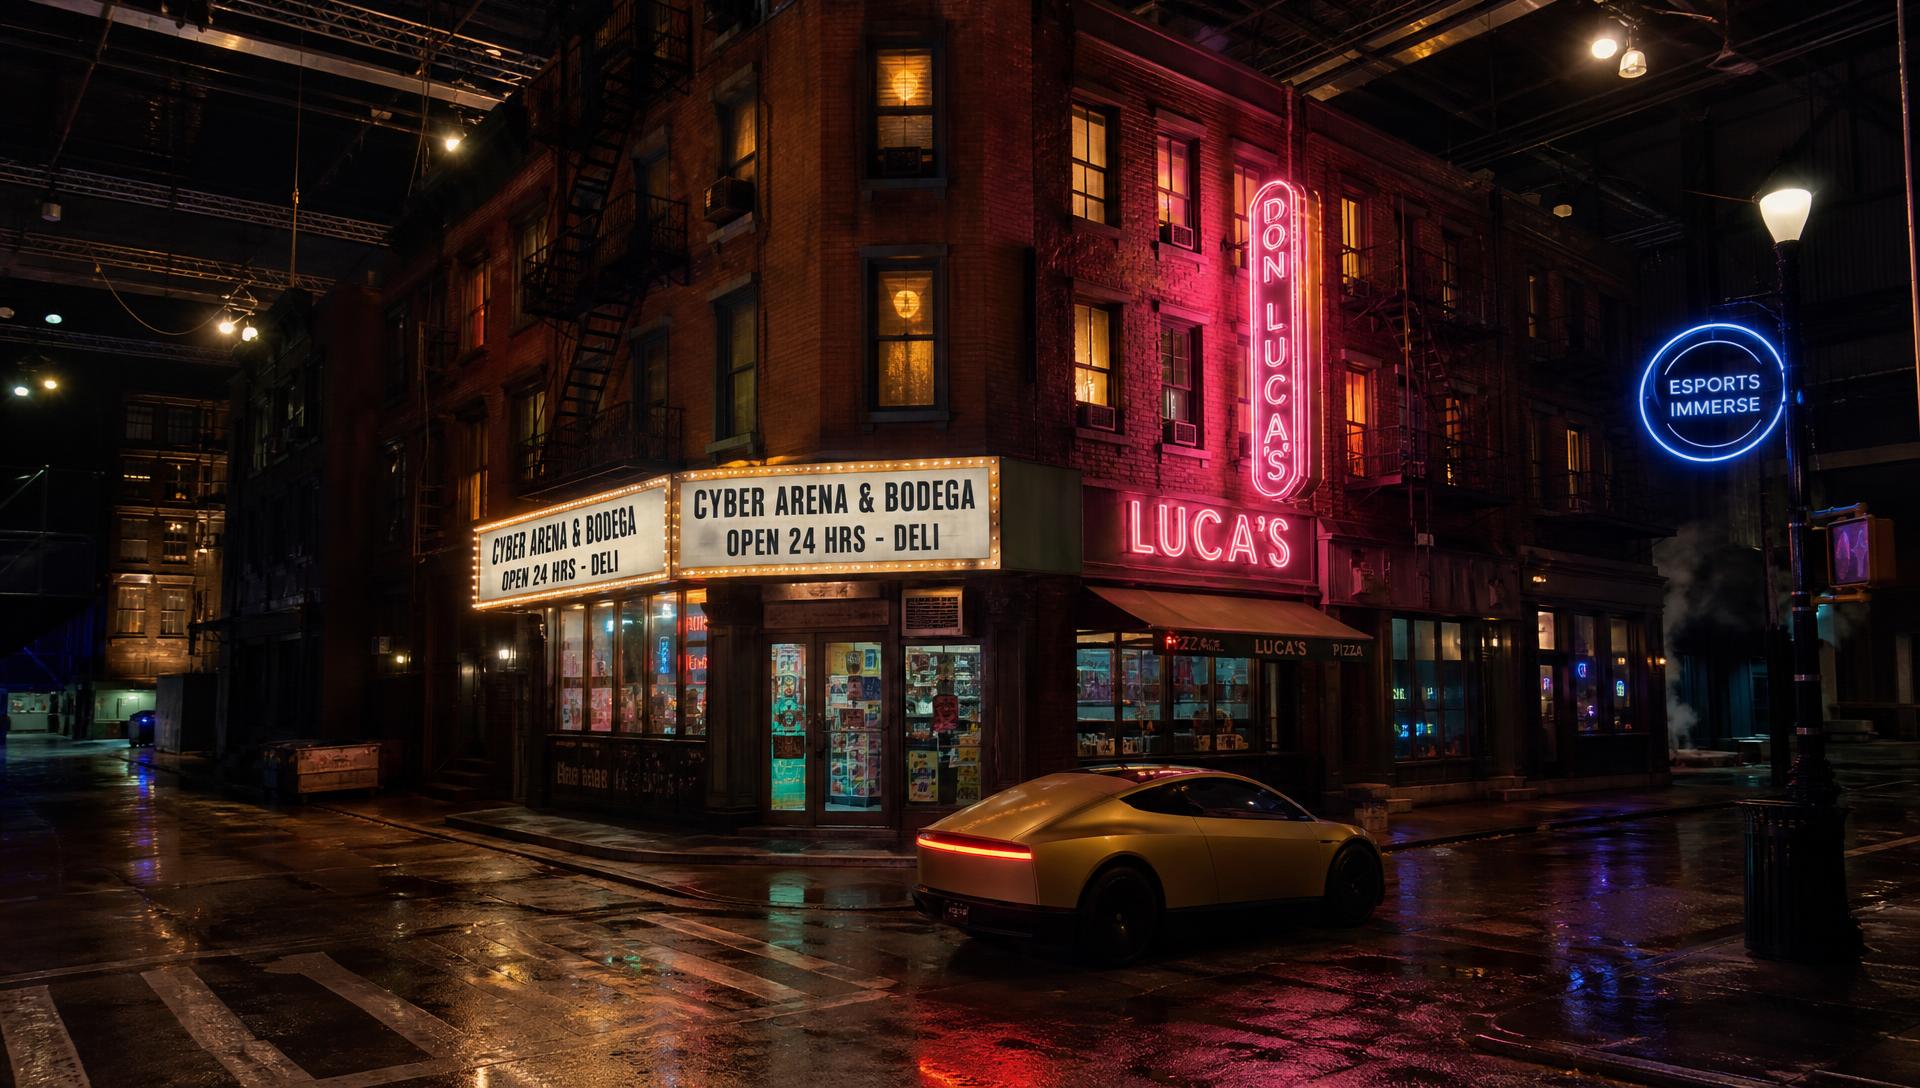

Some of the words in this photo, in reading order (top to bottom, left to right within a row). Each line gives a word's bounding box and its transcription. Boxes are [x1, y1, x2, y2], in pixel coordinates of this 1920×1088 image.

[1262, 198, 1285, 284] DON
[1669, 374, 1761, 395] ESPORTS
[1671, 397, 1761, 417] IMMERSE
[694, 487, 765, 519] CYBER
[775, 484, 848, 516] ARENA
[859, 482, 875, 513] &
[885, 479, 976, 512] BODEGA
[492, 531, 526, 566] CYBER
[530, 521, 567, 557] ARENA
[572, 518, 581, 548] &
[586, 505, 637, 545] BODEGA
[726, 528, 779, 557] OPEN
[789, 526, 816, 554] 24
[824, 525, 866, 554] HRS
[894, 523, 939, 551] DELI
[1131, 500, 1290, 568] LUCA'S
[502, 566, 529, 591] OPEN
[532, 563, 548, 586] 24
[552, 558, 576, 583] HRS
[591, 549, 618, 576] DELI
[1255, 638, 1307, 656] LUCA'S
[1332, 643, 1363, 657] PIZZA
